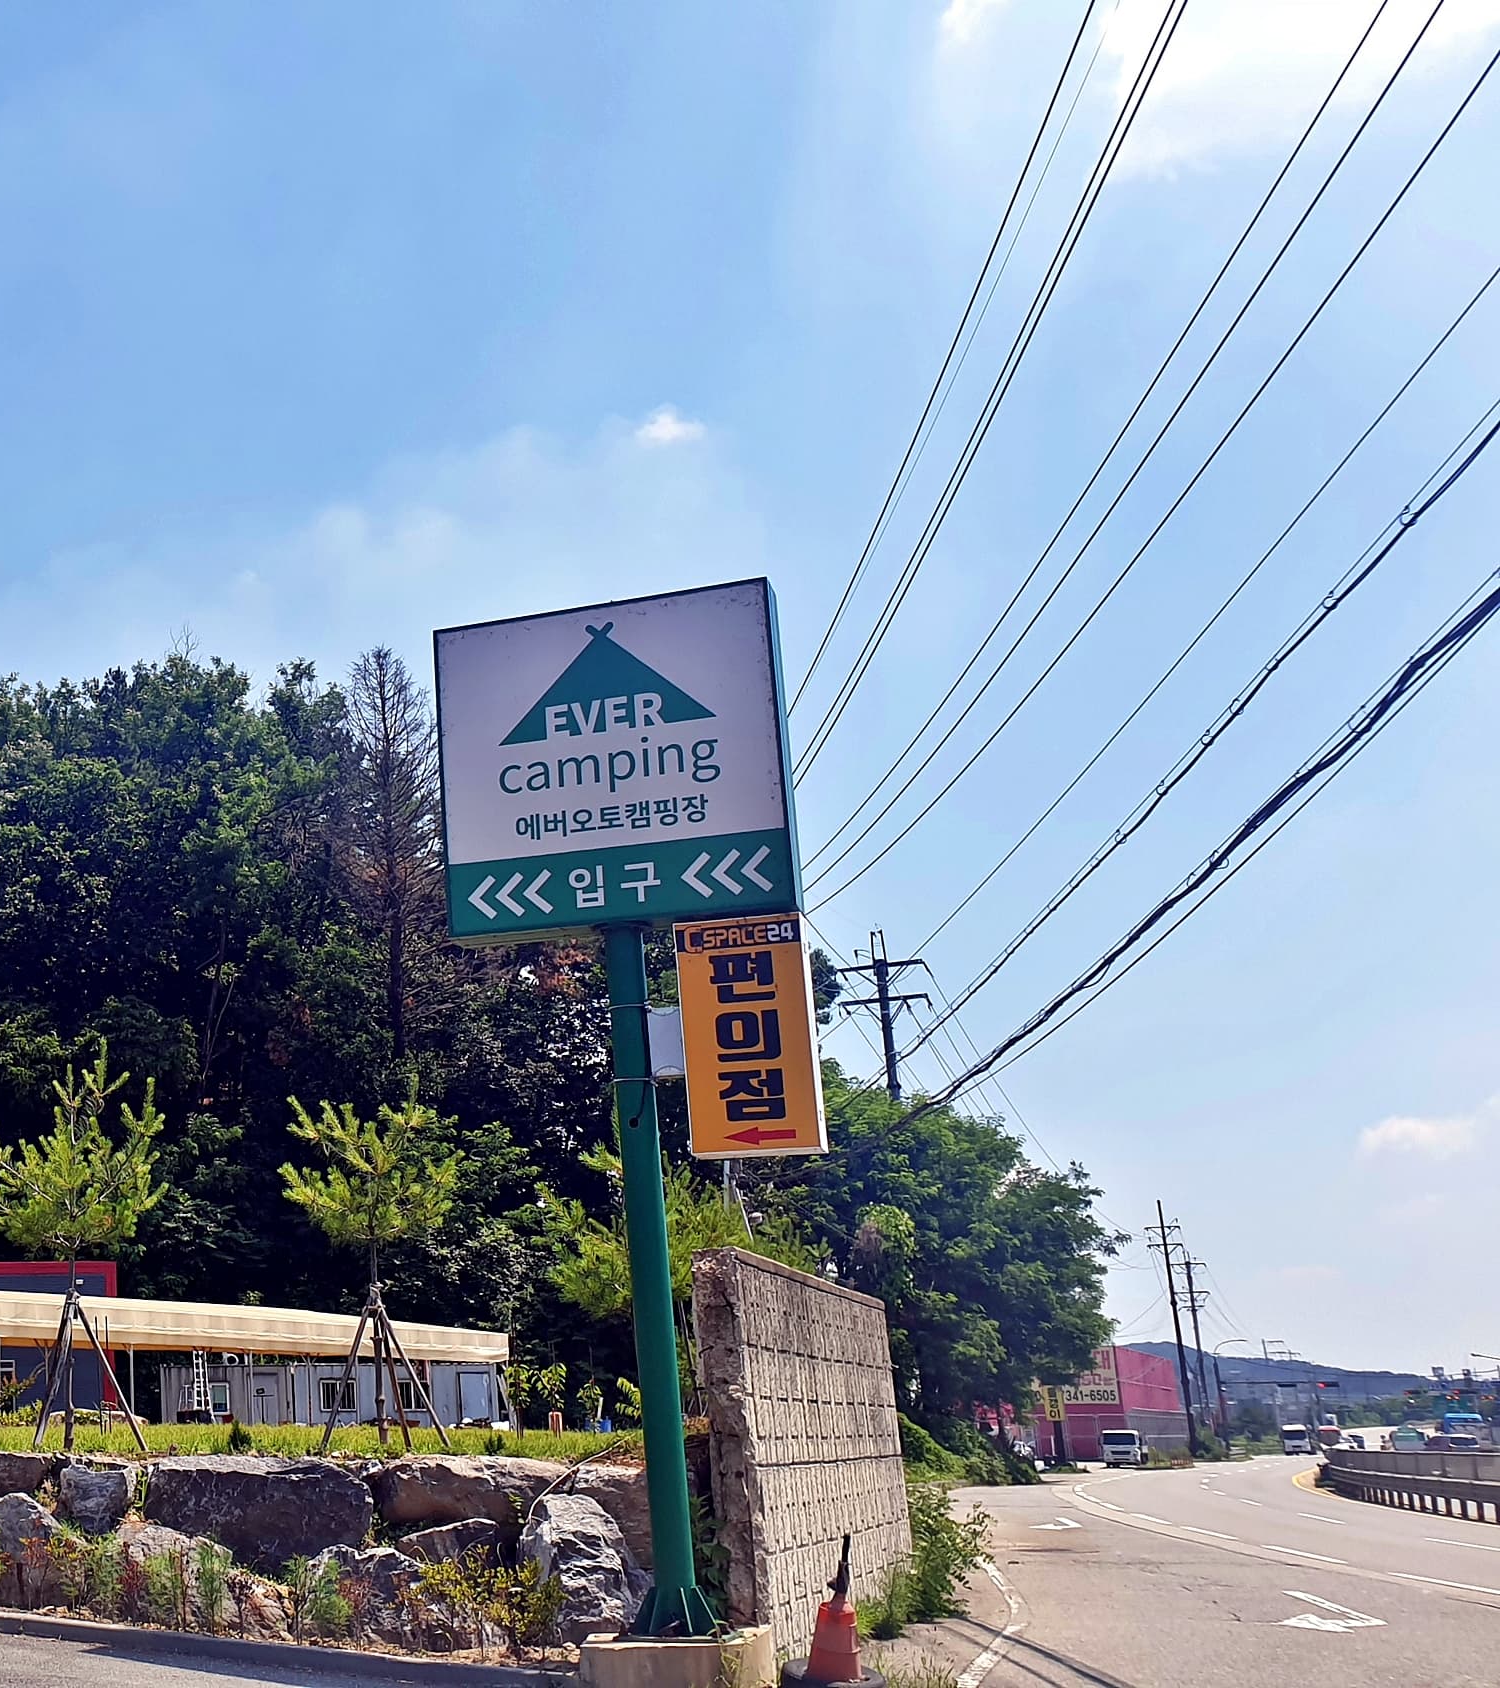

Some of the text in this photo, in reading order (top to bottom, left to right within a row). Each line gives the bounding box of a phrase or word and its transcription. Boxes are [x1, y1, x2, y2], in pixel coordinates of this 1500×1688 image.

[544, 691, 667, 740] EVER
[498, 736, 722, 794] camping
[514, 793, 709, 841] 에버오토캠핑장
[708, 951, 786, 1122] 편의점
